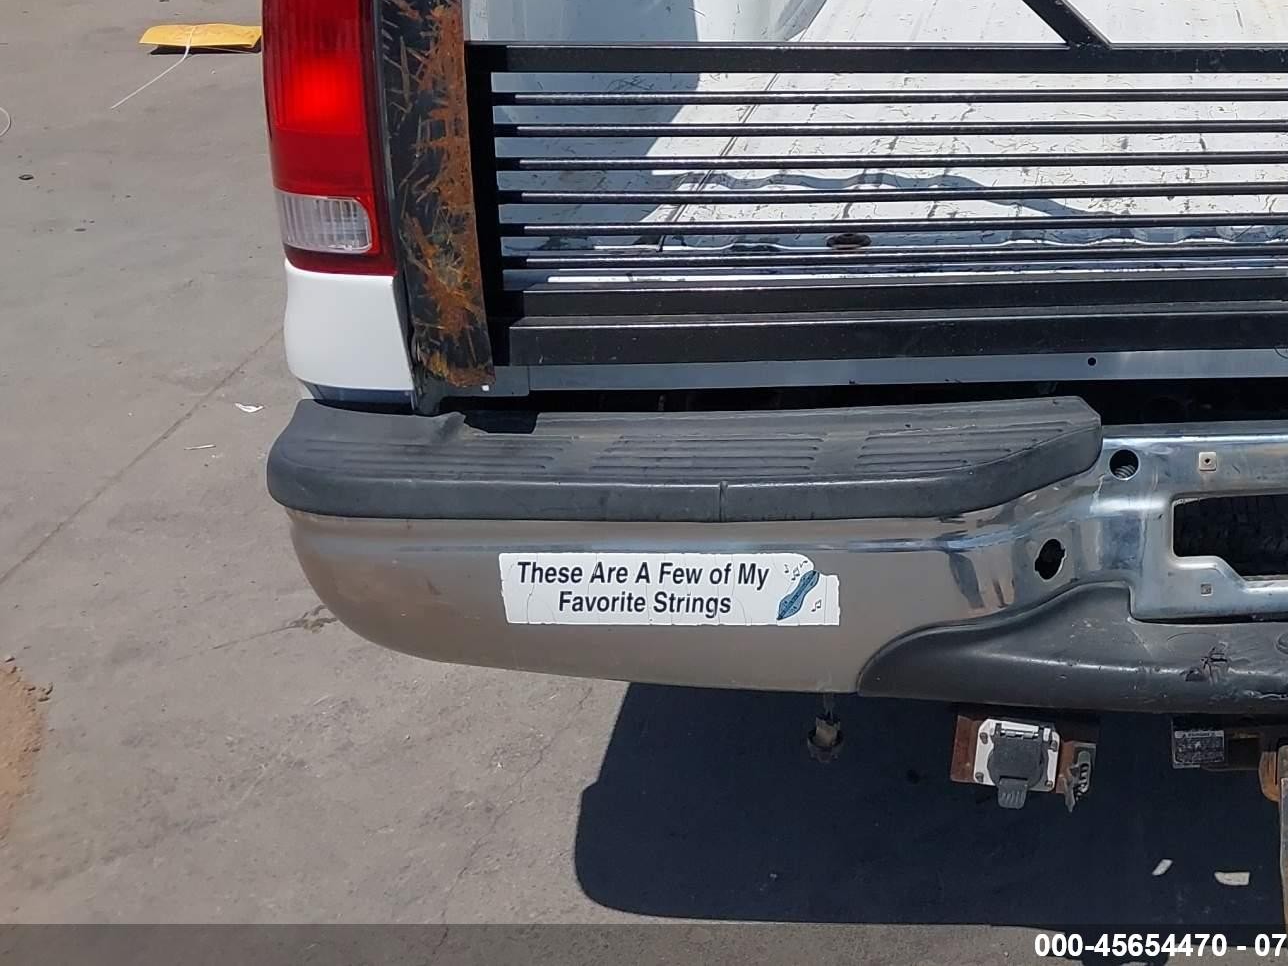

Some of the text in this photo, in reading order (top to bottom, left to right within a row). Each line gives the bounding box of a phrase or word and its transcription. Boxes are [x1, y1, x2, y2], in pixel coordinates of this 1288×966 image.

[517, 561, 770, 591] These Are A Few of My
[559, 590, 731, 619] Favorite Strings
